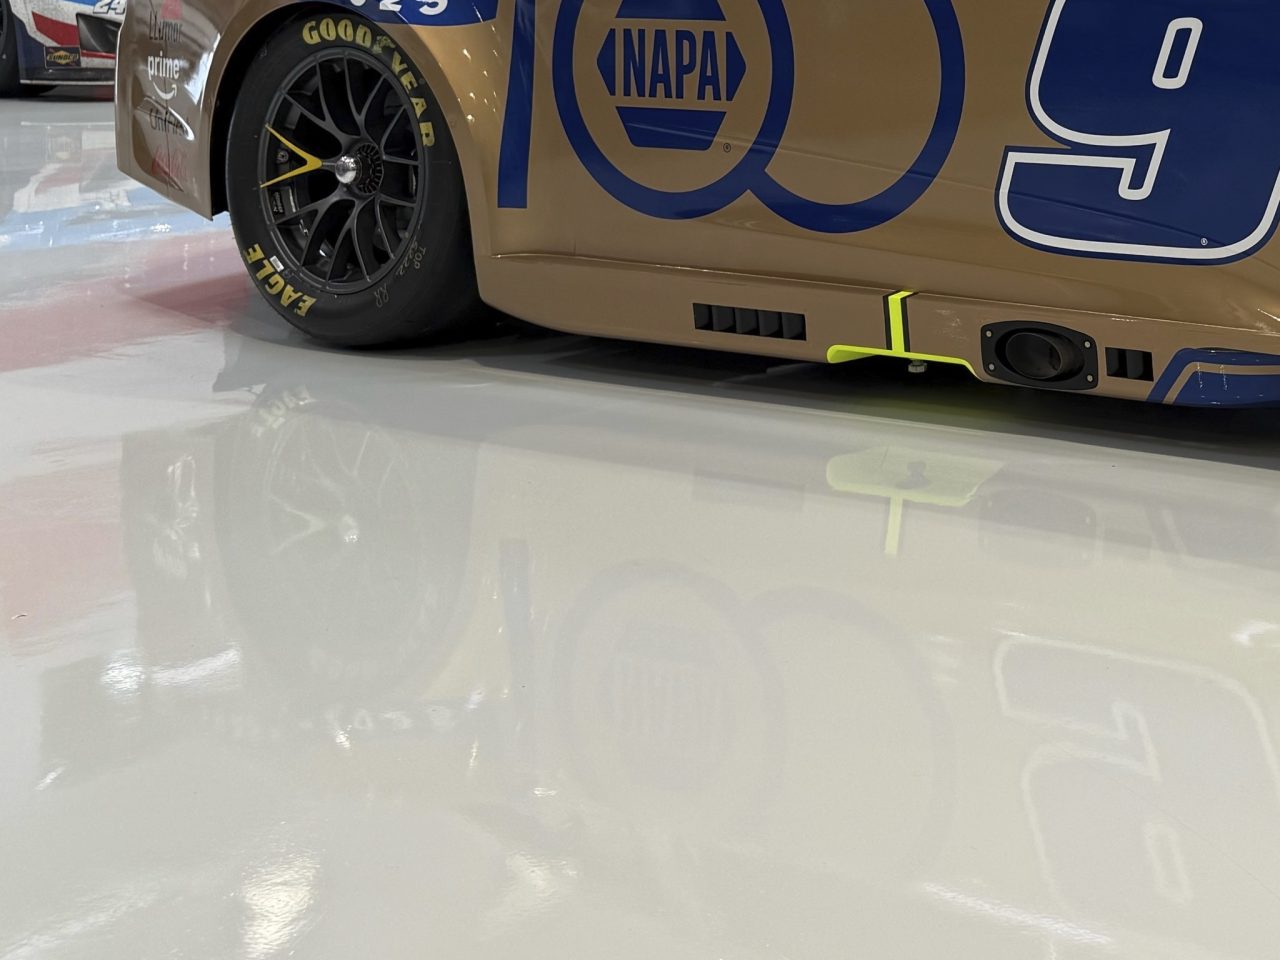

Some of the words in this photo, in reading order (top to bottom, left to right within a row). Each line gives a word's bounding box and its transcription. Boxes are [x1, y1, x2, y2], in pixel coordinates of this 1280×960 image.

[147, 50, 180, 81] prime
[302, 17, 436, 147] GOODYEAR
[623, 28, 722, 102] NAPA
[243, 243, 317, 318] EAGLE
